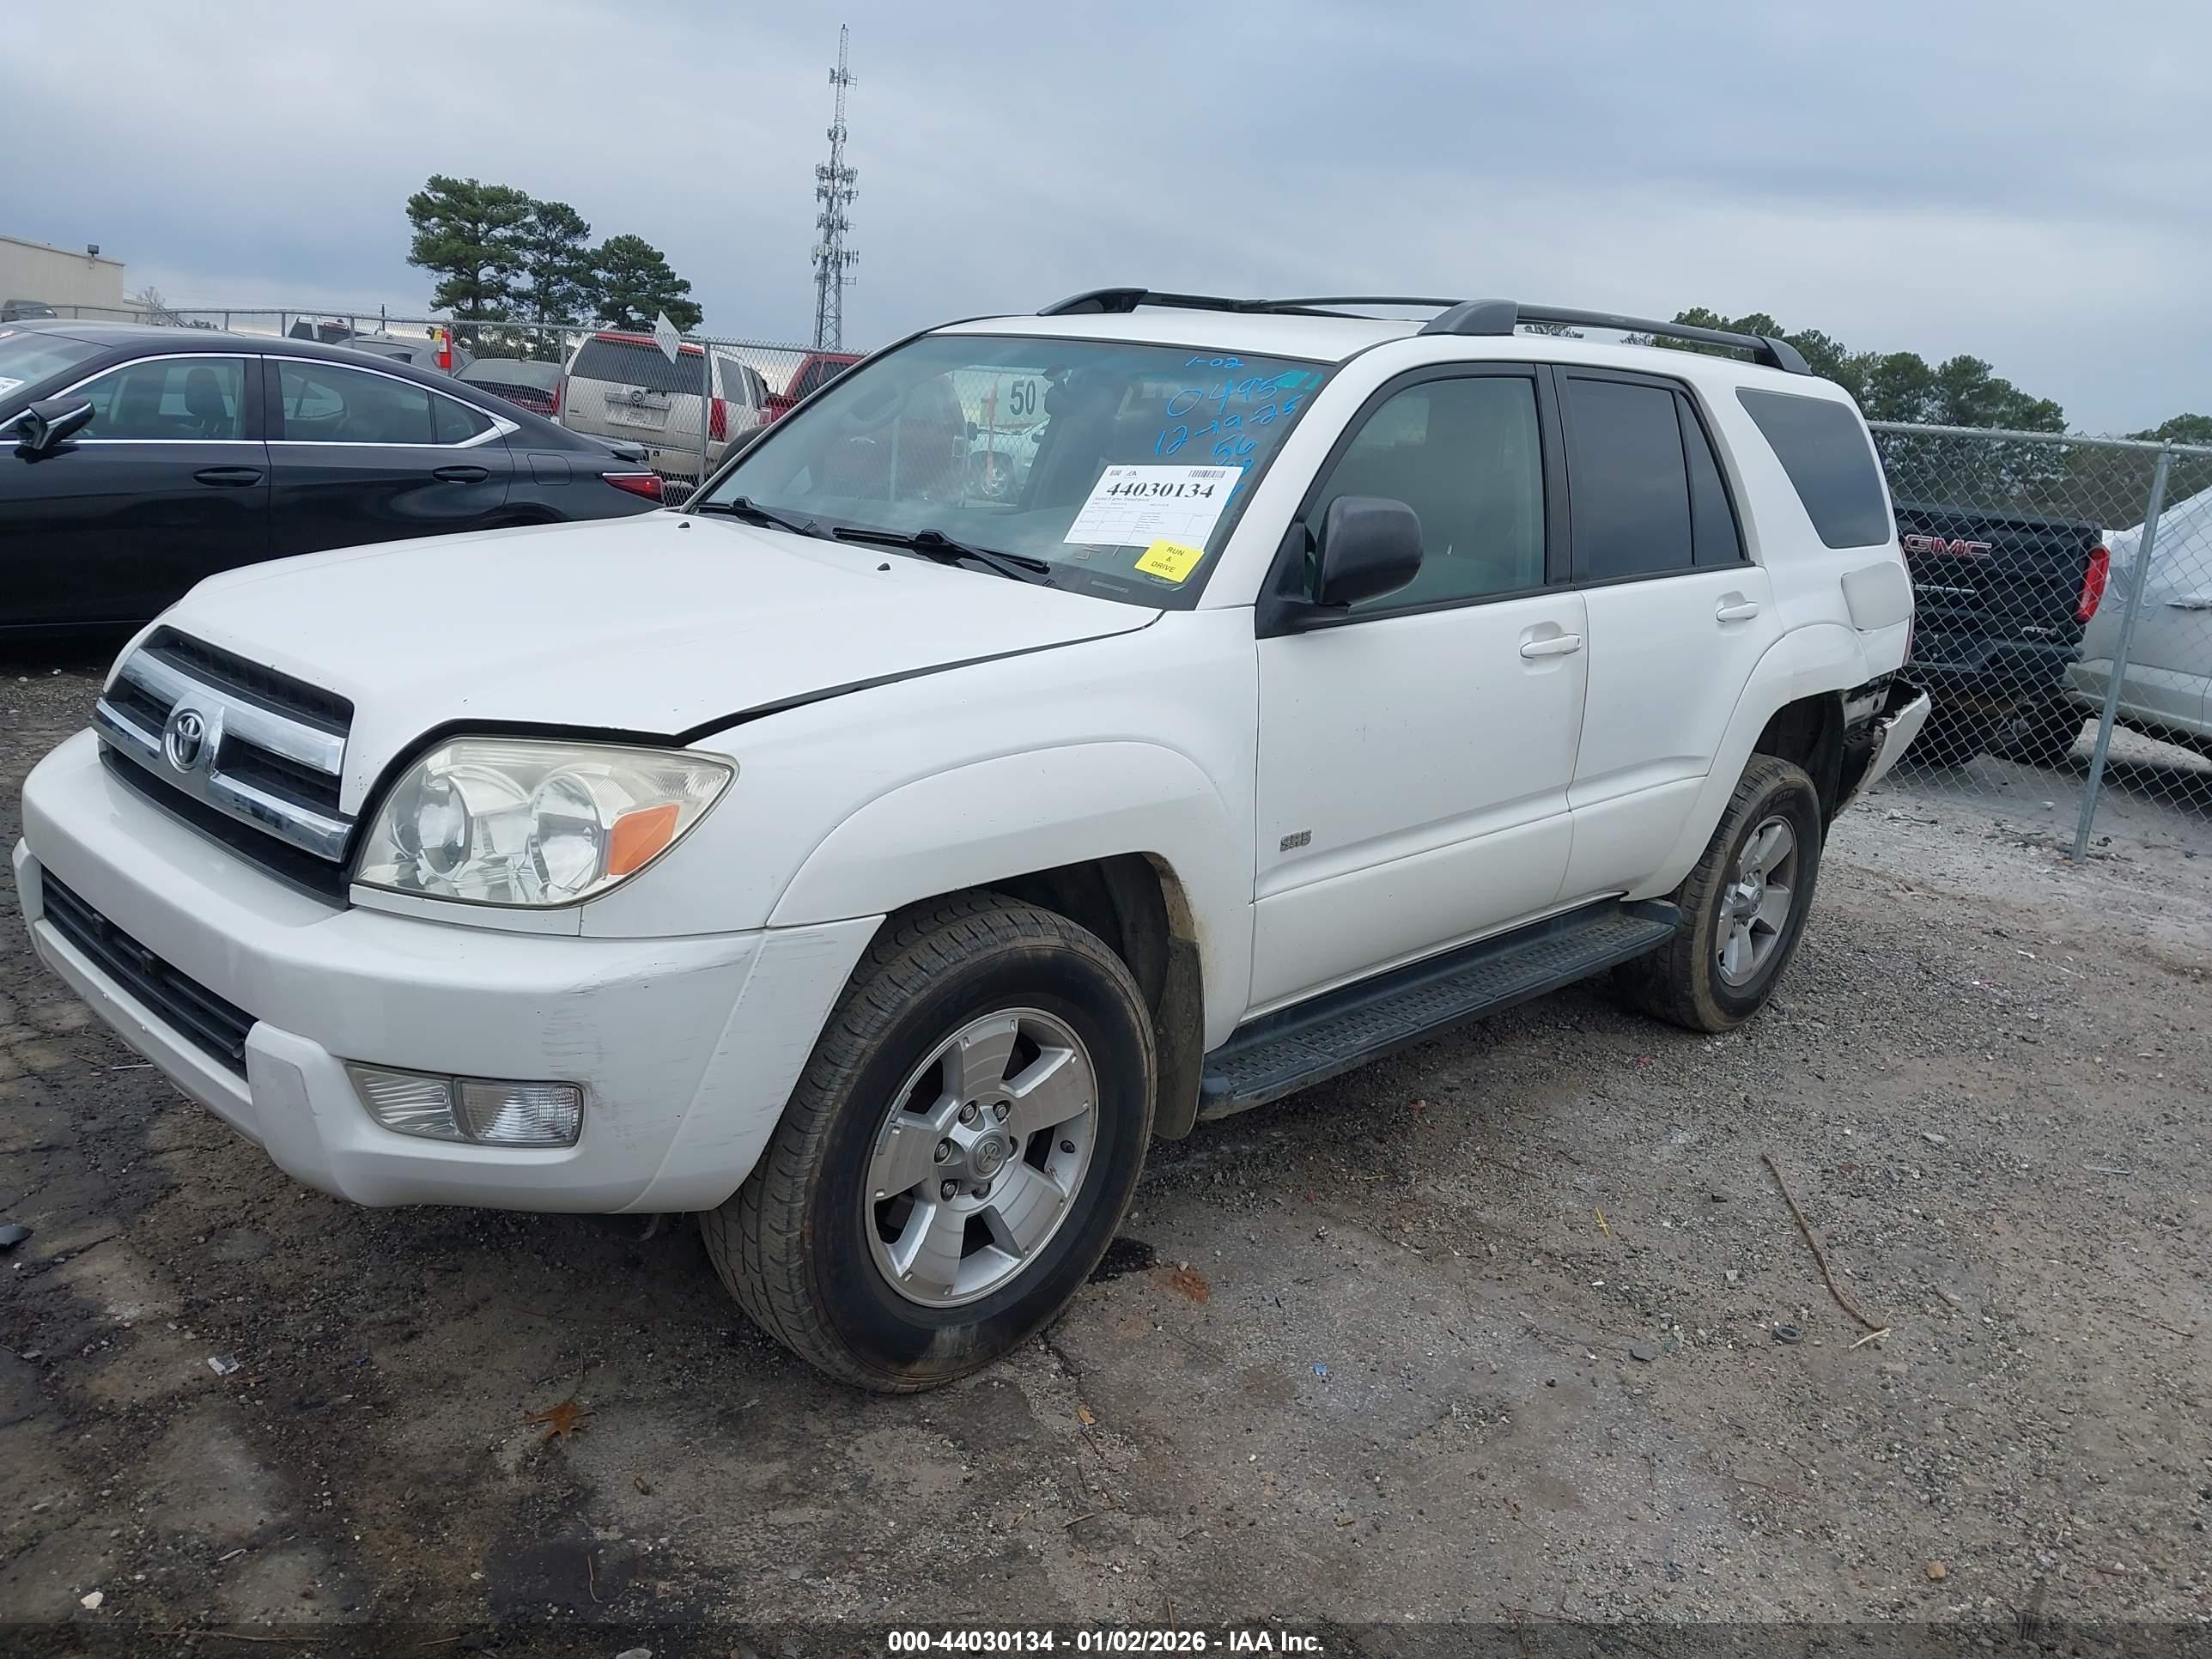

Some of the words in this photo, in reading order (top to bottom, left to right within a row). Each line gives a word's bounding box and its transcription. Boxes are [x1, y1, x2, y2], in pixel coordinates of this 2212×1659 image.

[1185, 356, 1244, 369] 1-02
[1009, 380, 1036, 416] 50
[1167, 371, 1292, 417] 0495
[1106, 483, 1216, 499] 44030134
[1166, 546, 1186, 556] RUN
[1905, 533, 1992, 560] GMC
[1151, 561, 1176, 573] DRIVE
